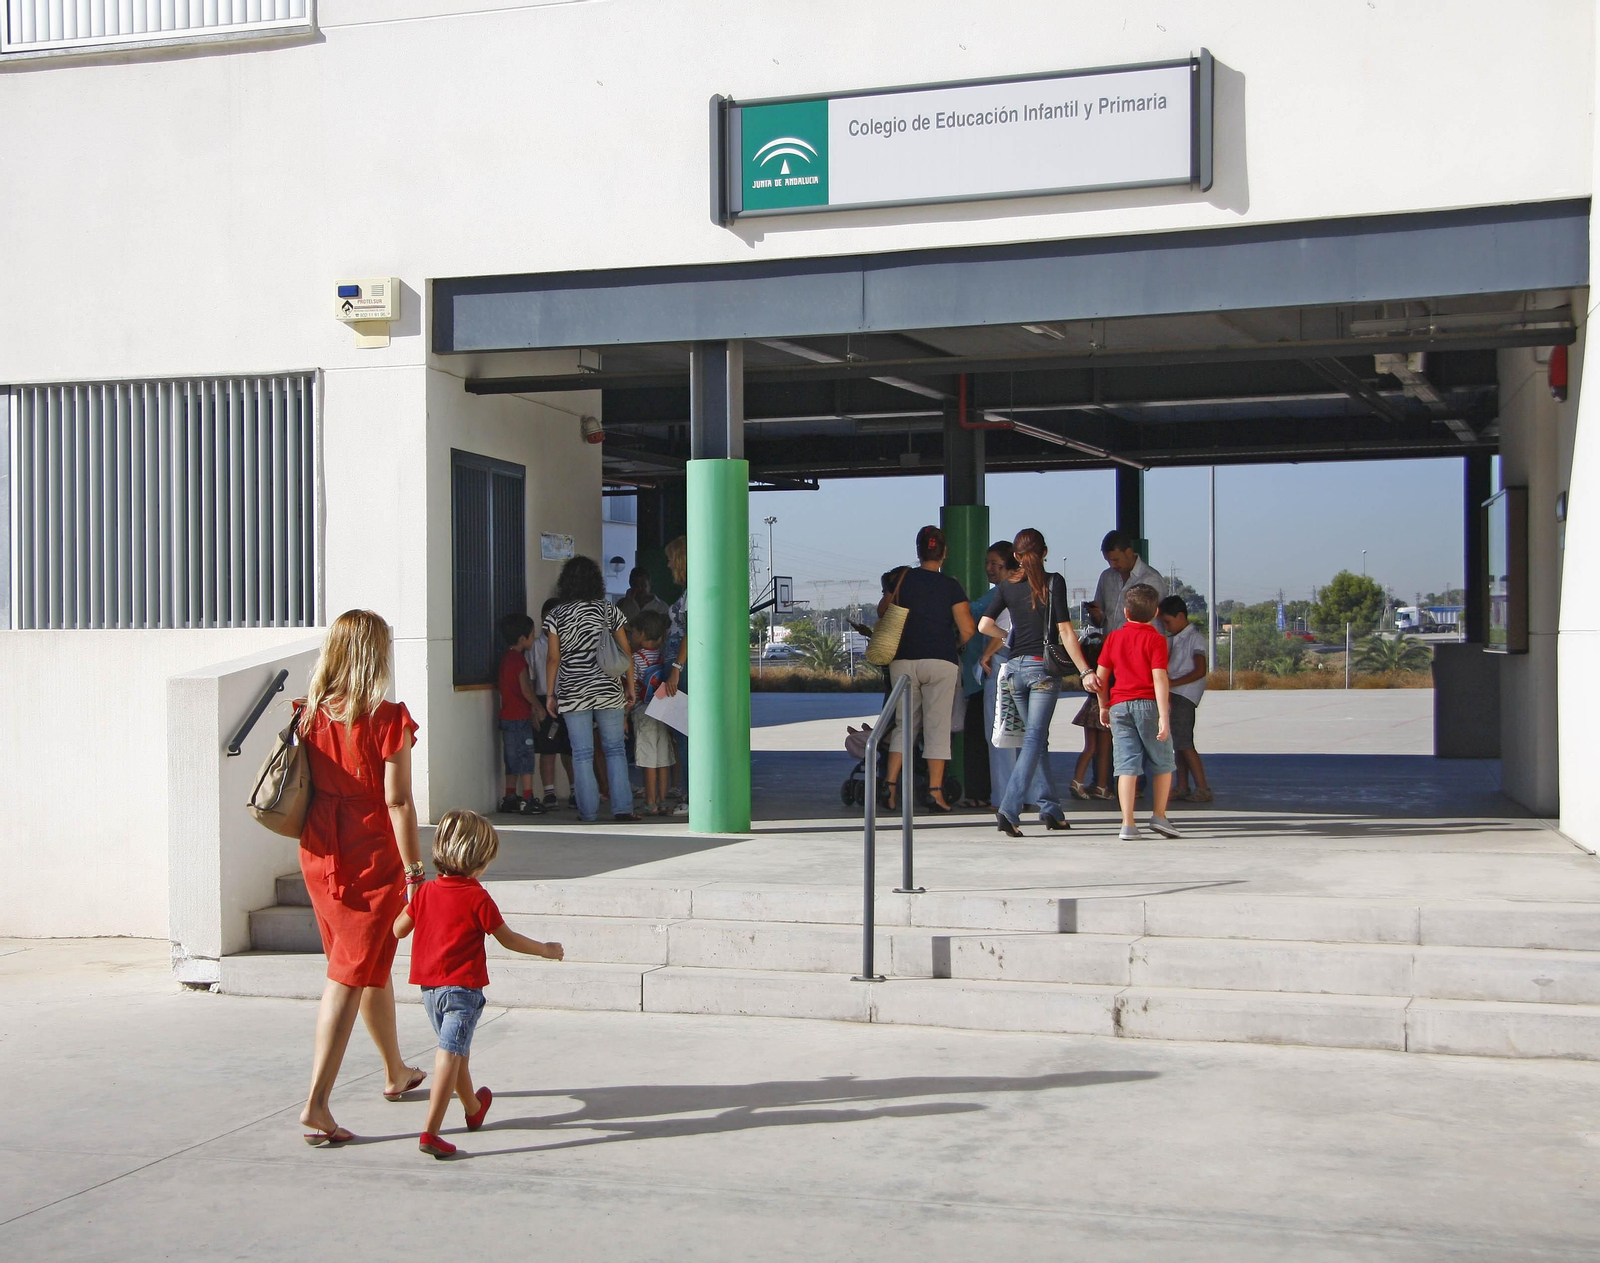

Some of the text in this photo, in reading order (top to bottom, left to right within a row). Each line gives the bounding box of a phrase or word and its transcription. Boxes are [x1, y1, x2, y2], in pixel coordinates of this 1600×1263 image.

[848, 93, 1167, 138] Colegio de Educación Infantil y Primaria
[752, 179, 772, 189] JUNTA
[774, 178, 783, 187] DE
